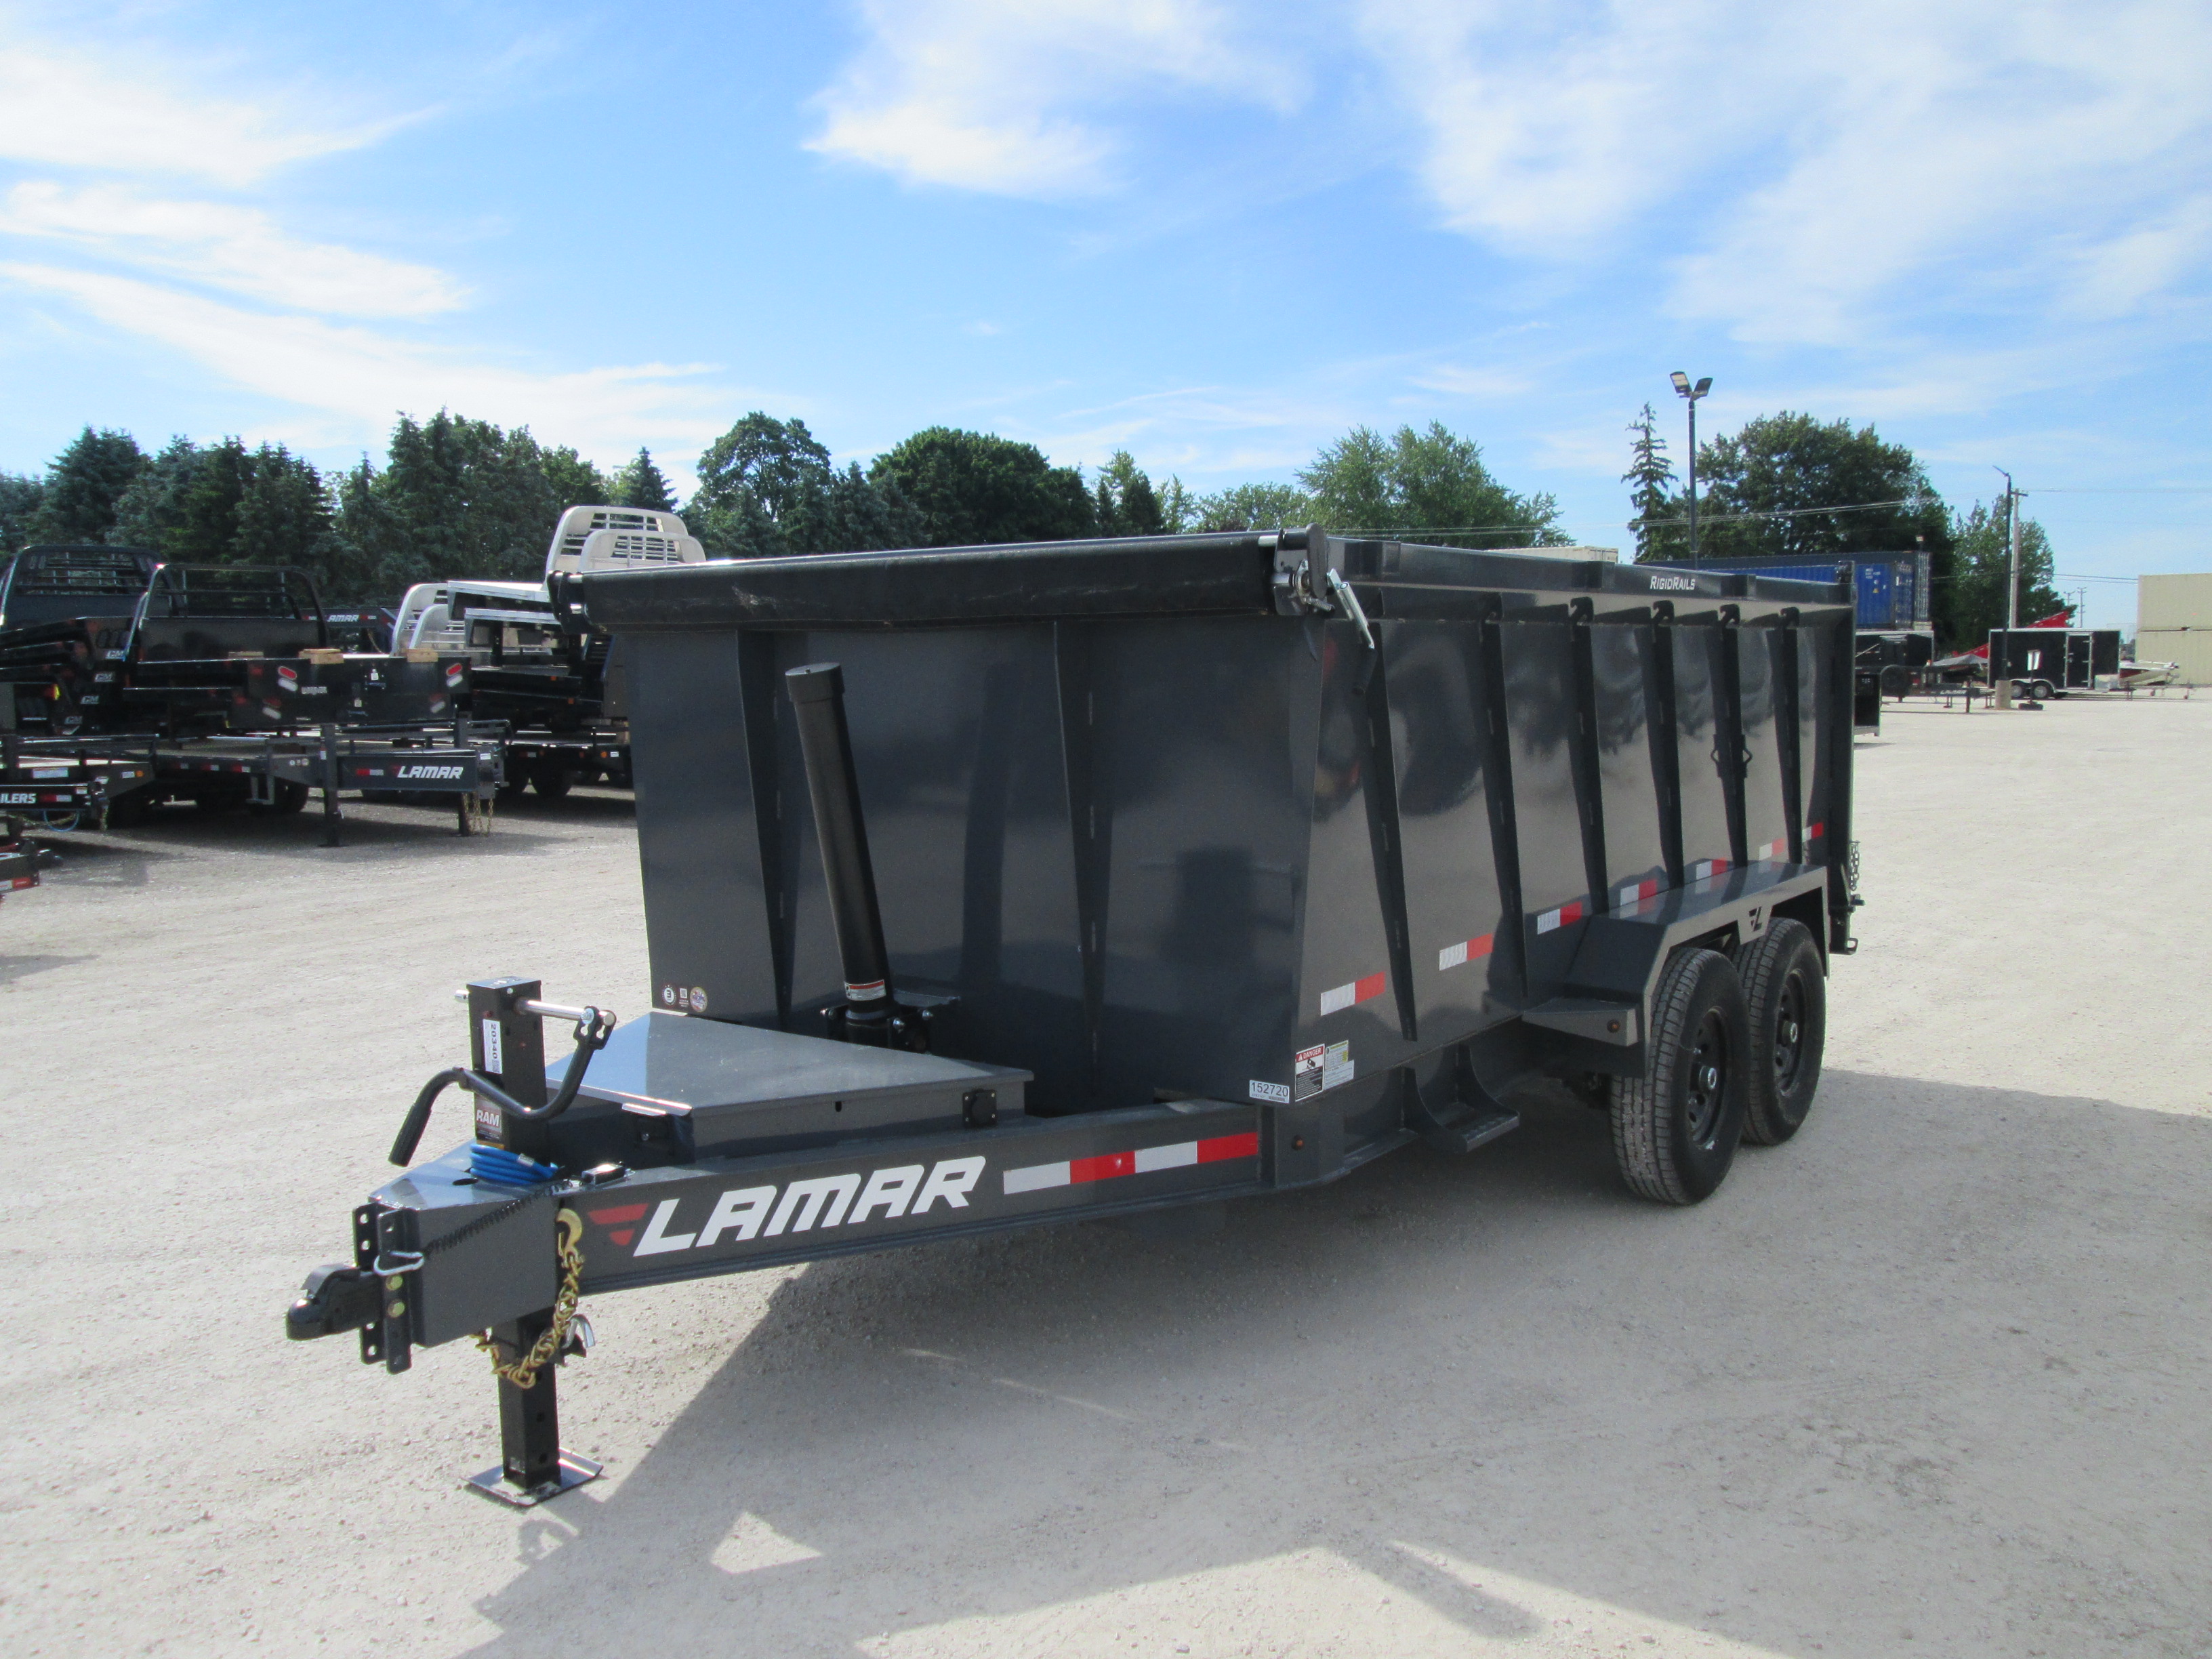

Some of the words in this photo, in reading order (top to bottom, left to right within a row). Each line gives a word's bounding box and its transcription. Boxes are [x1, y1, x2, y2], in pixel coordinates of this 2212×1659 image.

[397, 766, 464, 779] LAMAR
[1303, 1047, 1322, 1059] DANGER
[1251, 1082, 1289, 1097] 152720
[476, 1109, 499, 1127] RAM
[632, 1155, 987, 1257] LAMAR
